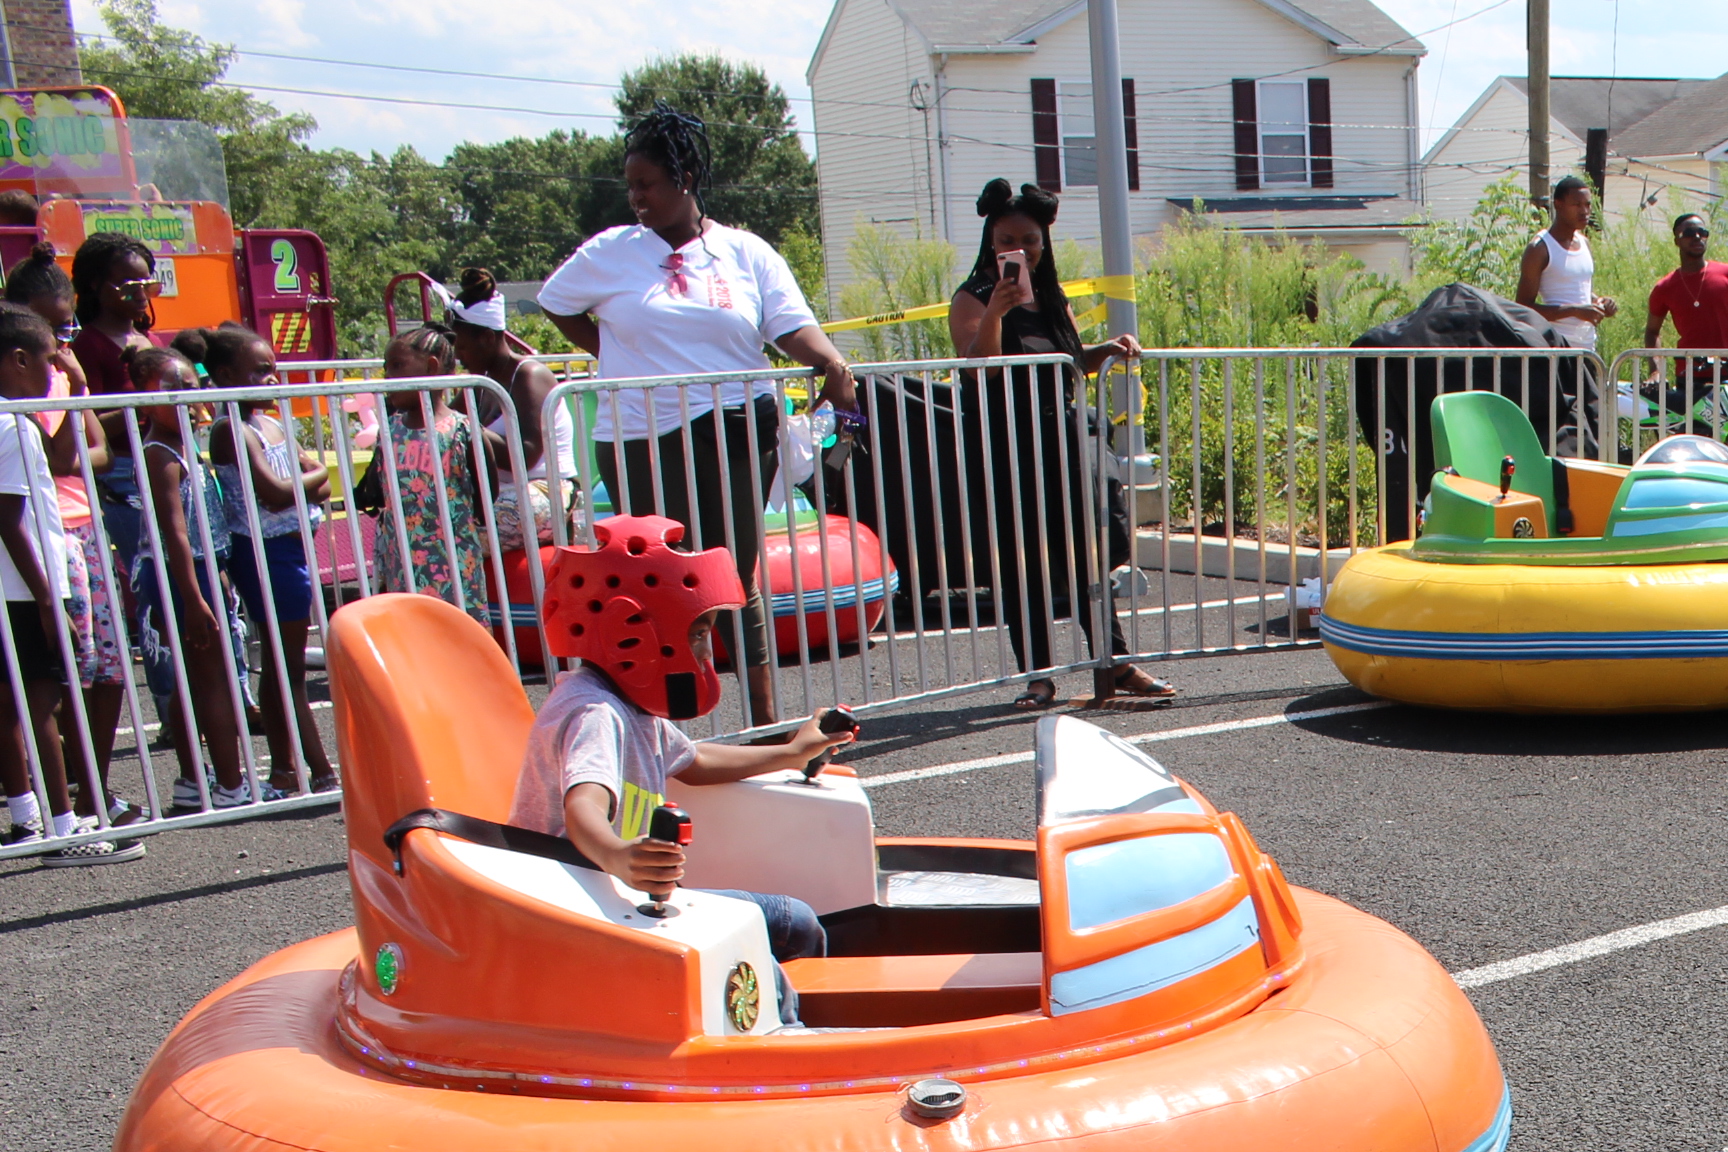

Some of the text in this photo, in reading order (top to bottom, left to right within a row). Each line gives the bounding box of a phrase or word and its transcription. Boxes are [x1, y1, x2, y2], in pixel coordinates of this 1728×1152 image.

[15, 115, 105, 158] SONIC
[141, 218, 185, 240] SONIC
[271, 238, 301, 293] 2
[866, 311, 905, 325] CAUTION
